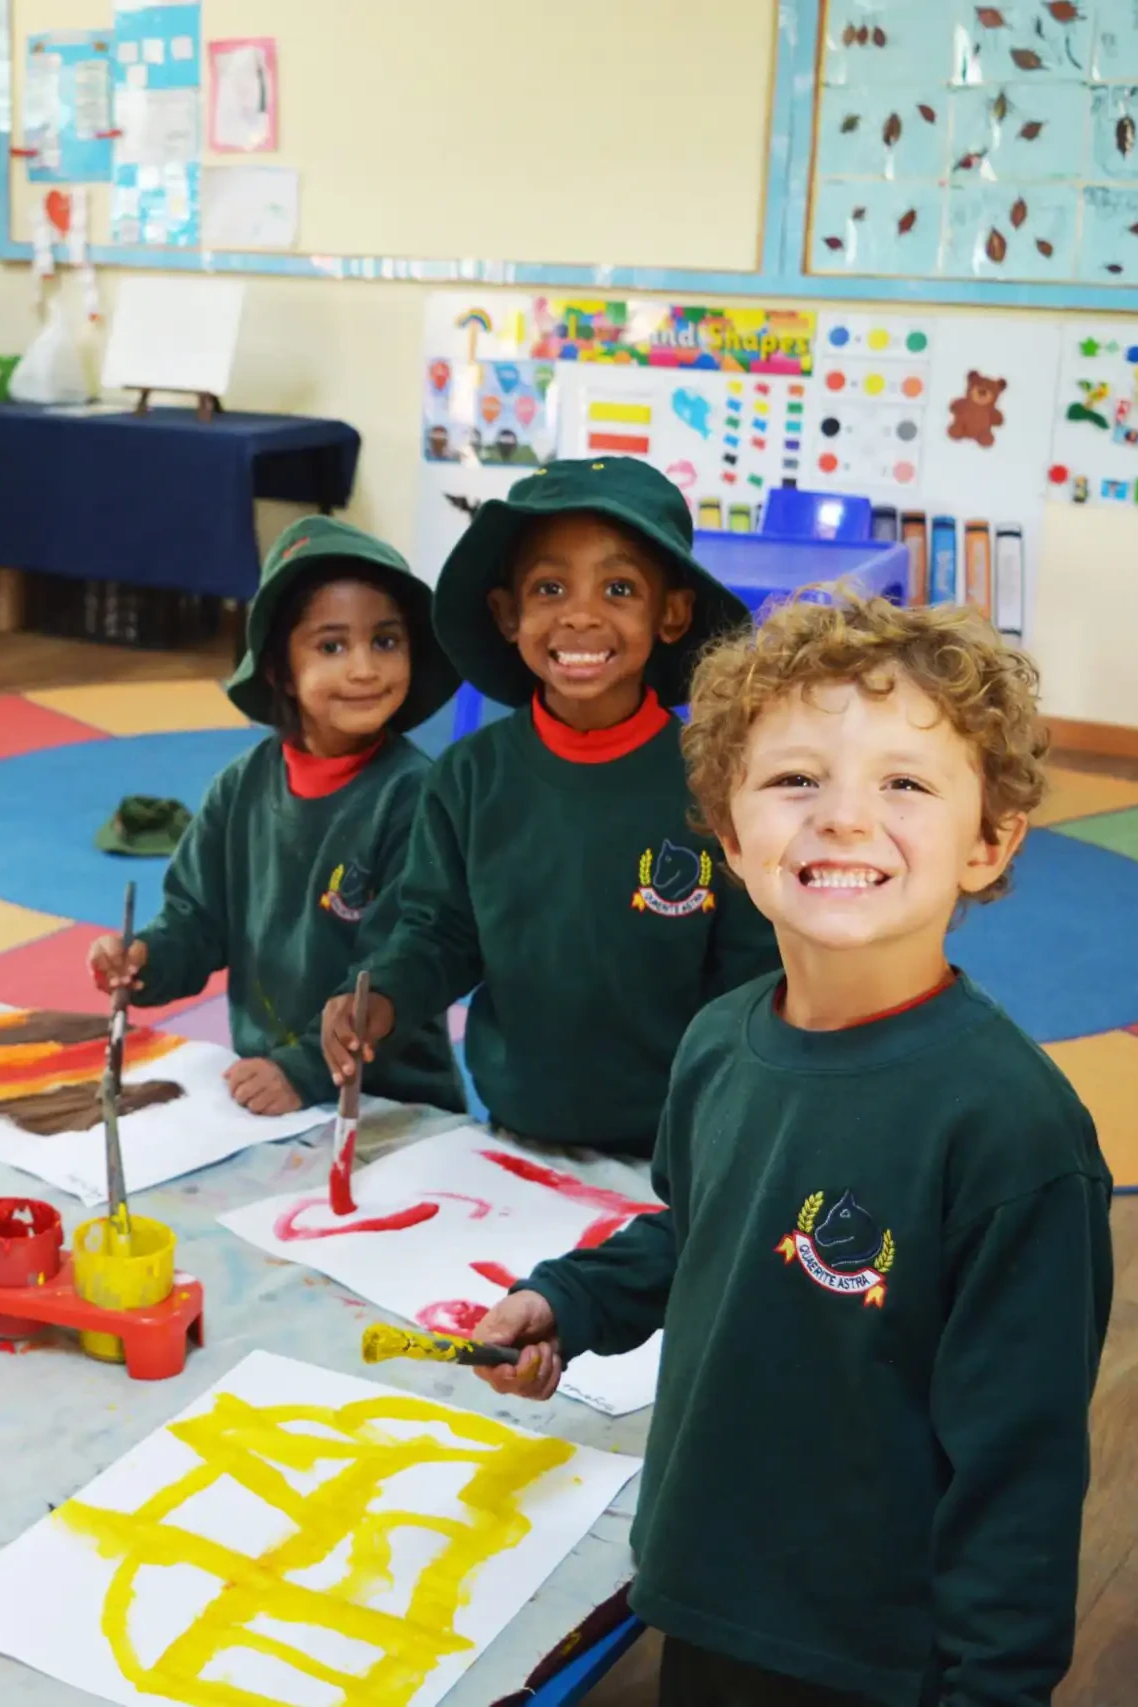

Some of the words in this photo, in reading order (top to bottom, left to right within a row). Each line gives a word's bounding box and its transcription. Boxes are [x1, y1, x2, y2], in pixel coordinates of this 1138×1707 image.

[708, 323, 810, 361] Shapes
[799, 1243, 836, 1287] QUAERITE
[837, 1273, 871, 1290] ASTRA
